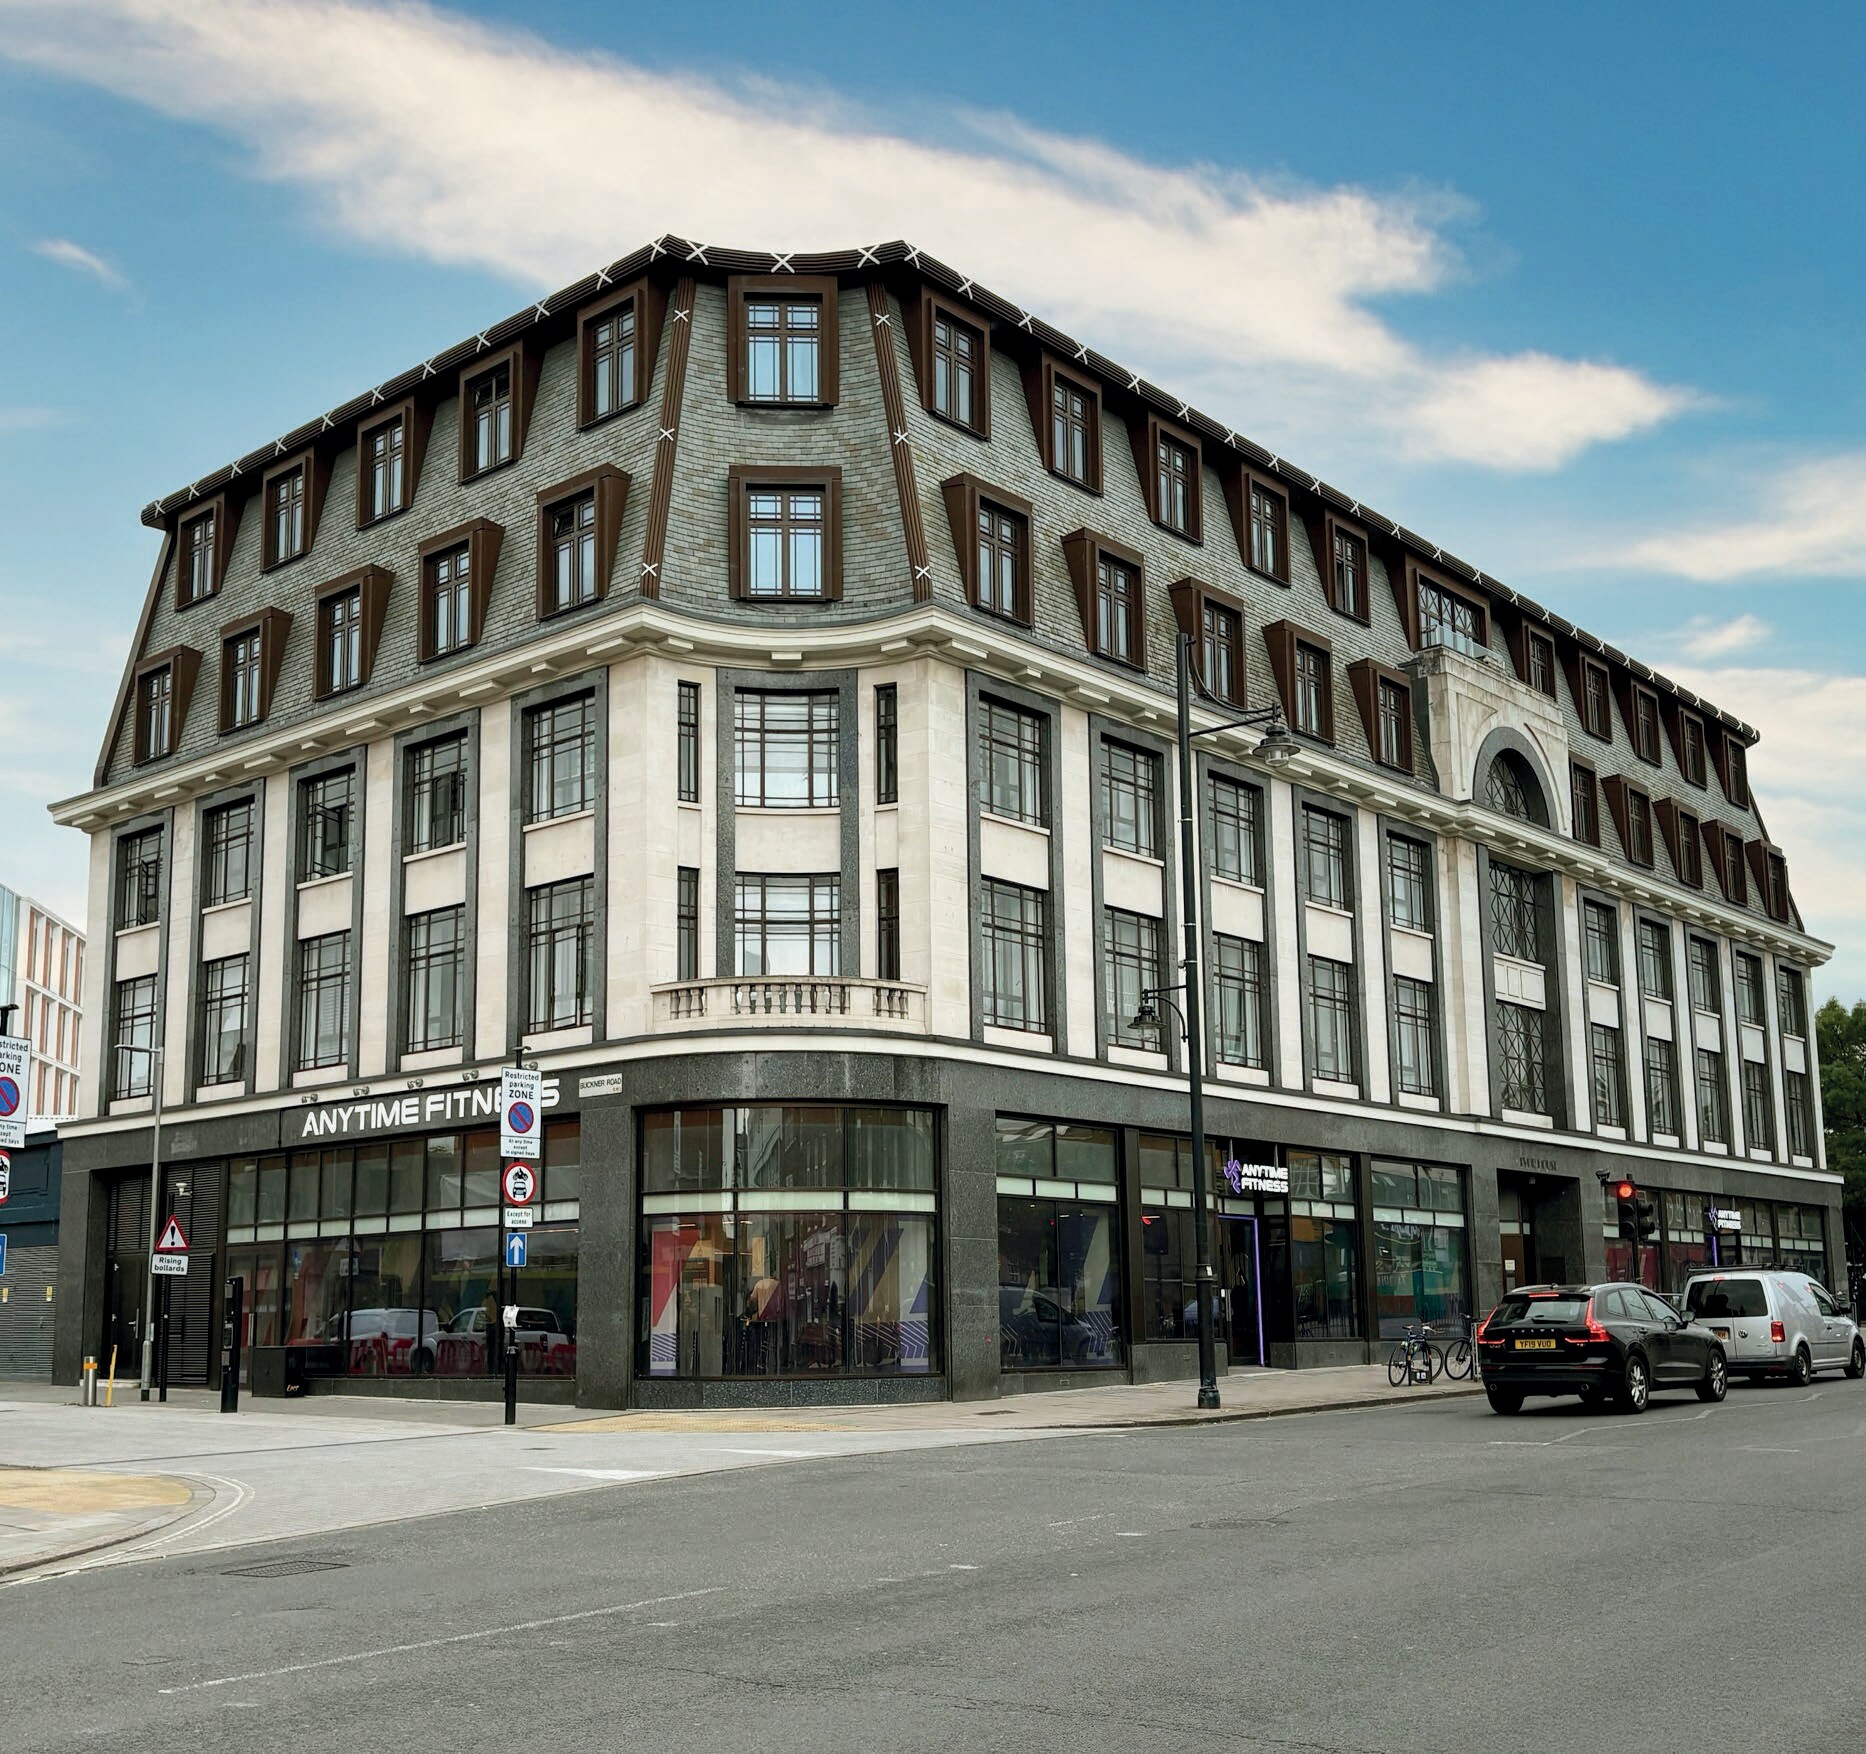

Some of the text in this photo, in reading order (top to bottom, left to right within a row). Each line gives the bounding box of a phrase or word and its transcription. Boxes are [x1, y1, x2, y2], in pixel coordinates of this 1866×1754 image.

[505, 1071, 539, 1080] Restricted
[509, 1081, 535, 1090] parking
[606, 1077, 621, 1086] ROAD
[509, 1090, 534, 1100] ZONE
[302, 1078, 560, 1137] ANYTIME FITNS
[1241, 1163, 1288, 1179] ANYTIME
[1241, 1177, 1289, 1193] FITNESS
[507, 1210, 523, 1218] Except
[159, 1257, 182, 1265] Rising
[154, 1264, 184, 1272] bollards
[1519, 1340, 1536, 1348] YF19
